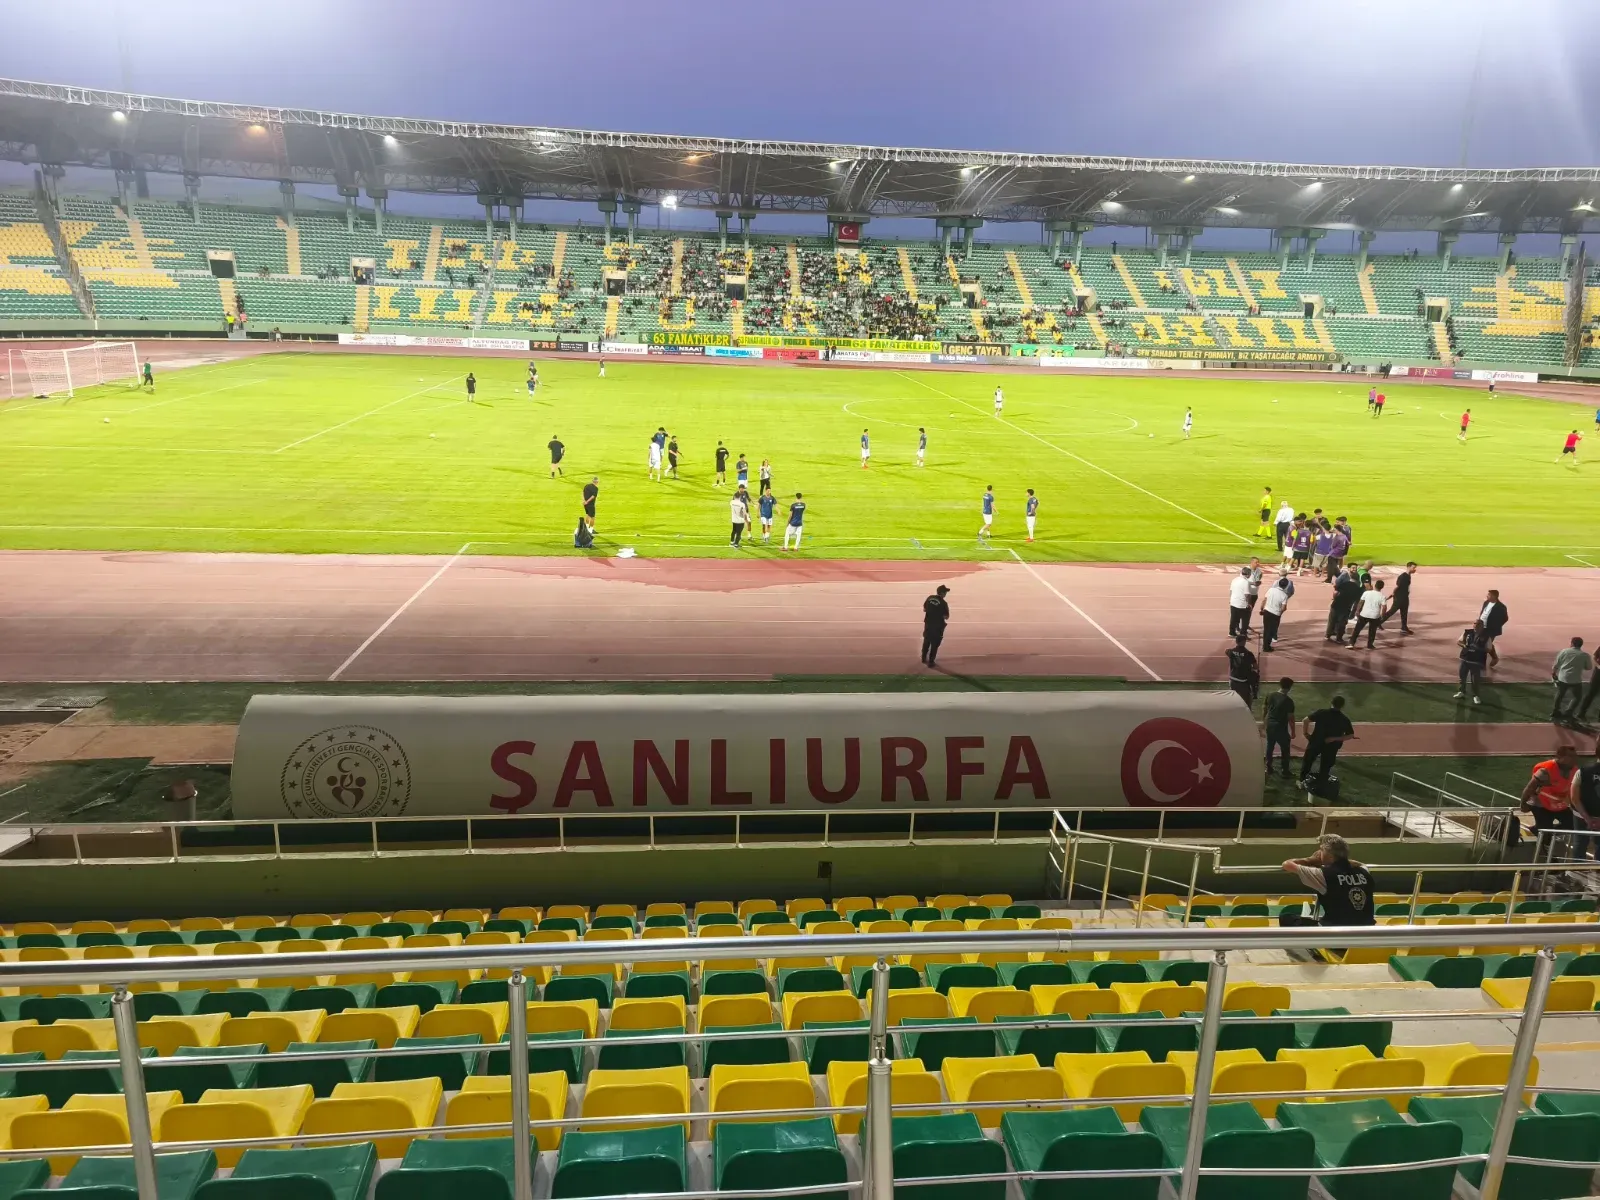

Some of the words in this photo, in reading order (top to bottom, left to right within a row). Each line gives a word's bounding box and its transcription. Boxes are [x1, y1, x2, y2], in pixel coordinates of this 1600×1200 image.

[653, 332, 666, 344] 63
[852, 339, 867, 348] 63
[975, 345, 1002, 356] TAYFA
[1152, 349, 1177, 358] SAHADA
[489, 735, 1052, 815] ŞANLIURFA
